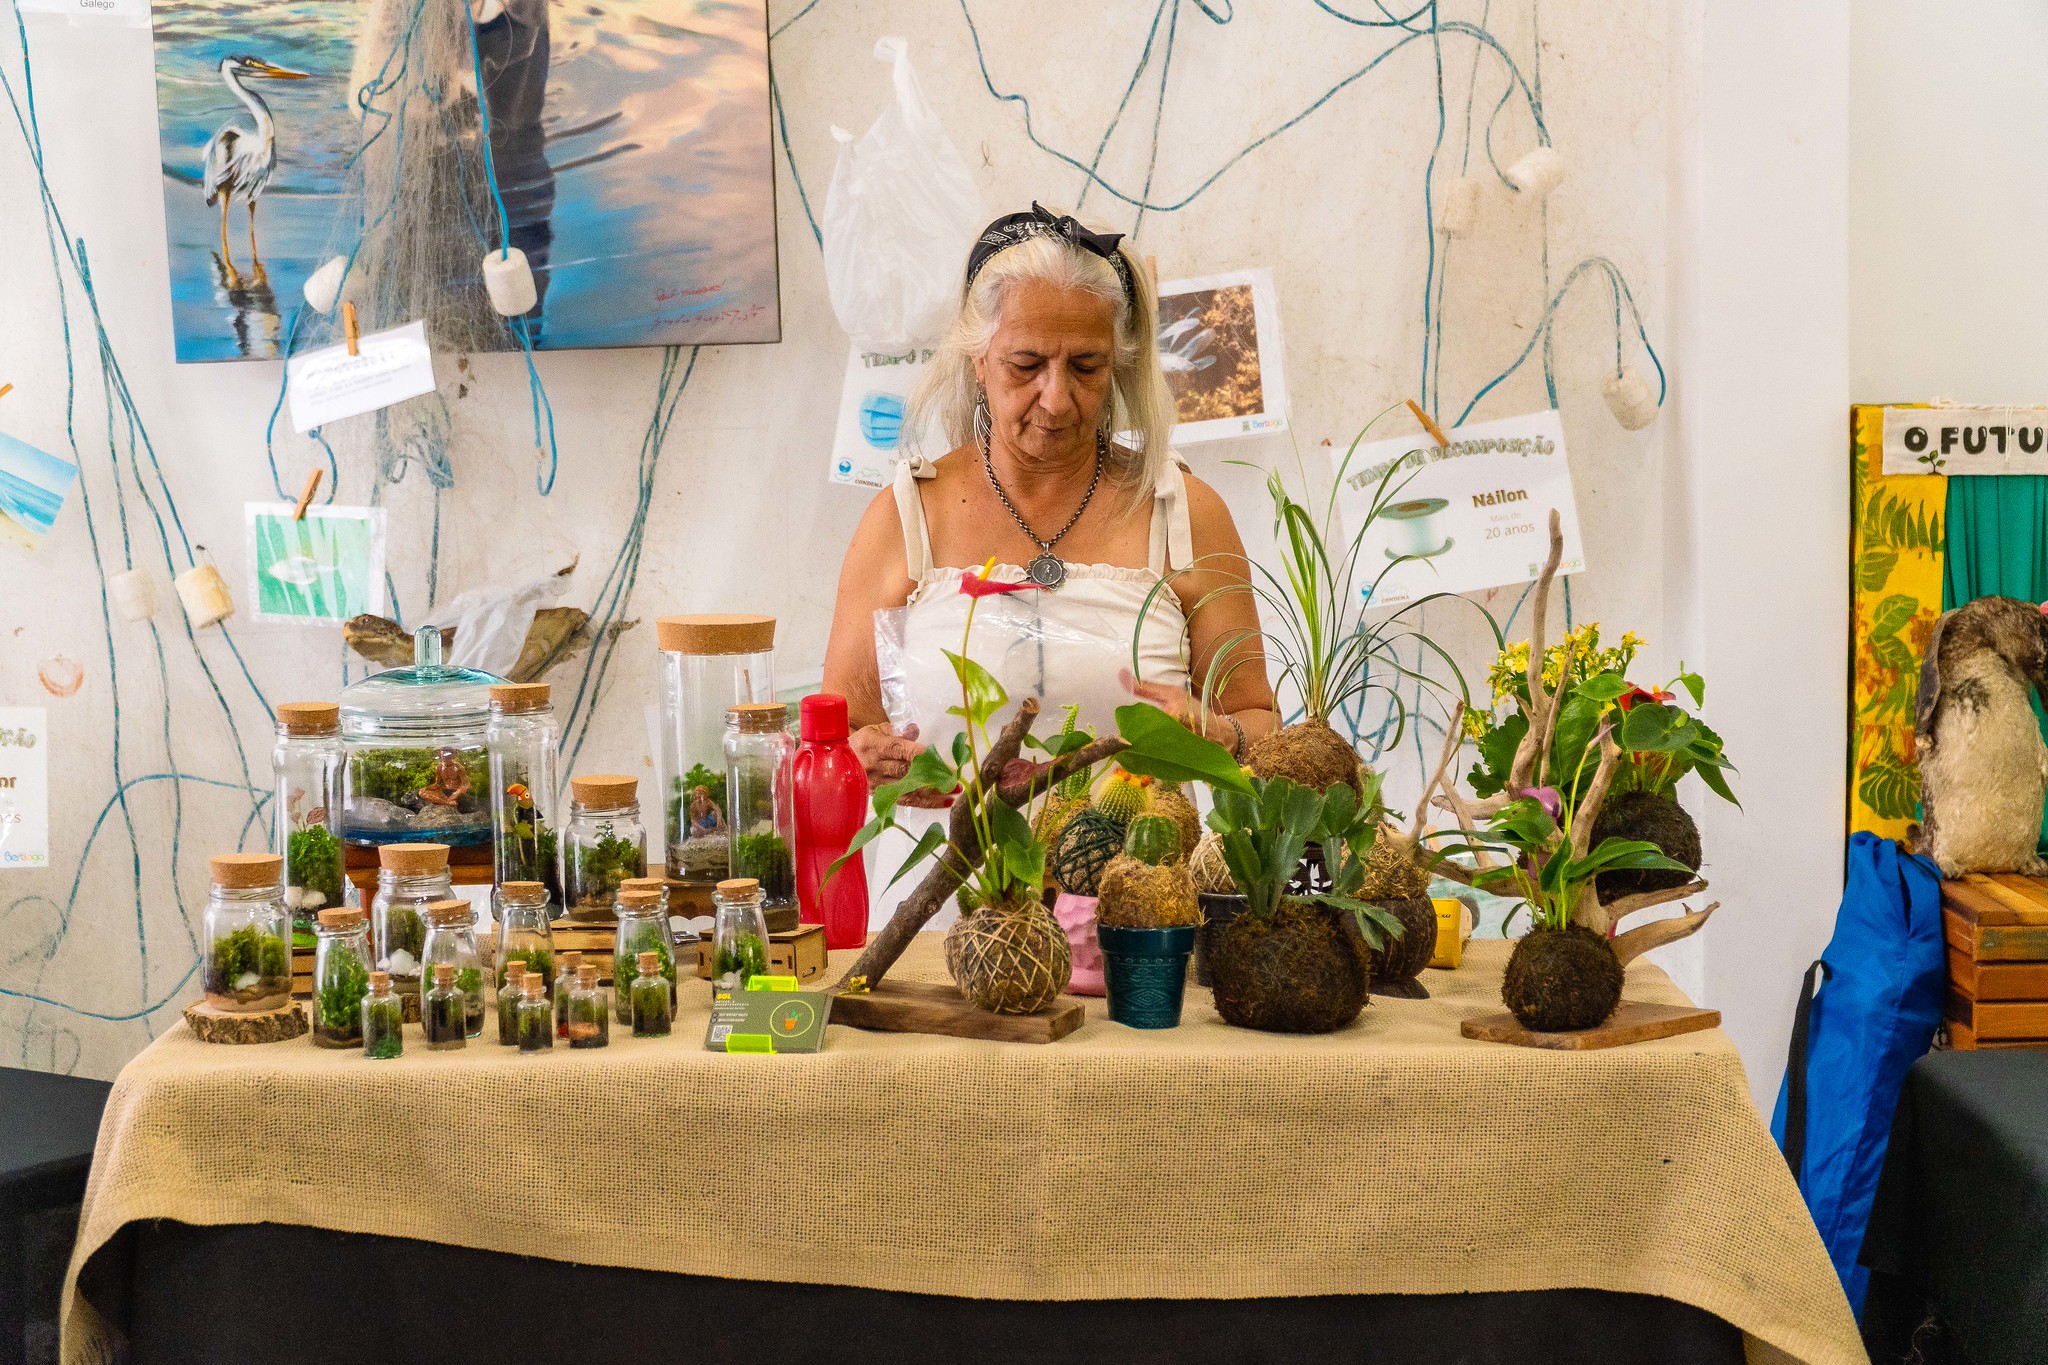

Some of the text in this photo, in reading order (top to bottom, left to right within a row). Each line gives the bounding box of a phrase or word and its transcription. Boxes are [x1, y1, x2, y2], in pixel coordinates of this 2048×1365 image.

[80, 0, 115, 10] Galego
[1904, 426, 2048, 455] O FUTU
[854, 479, 883, 488] CONDEMA
[1472, 489, 1529, 508] Náilon
[1485, 523, 1536, 540] 20 anos
